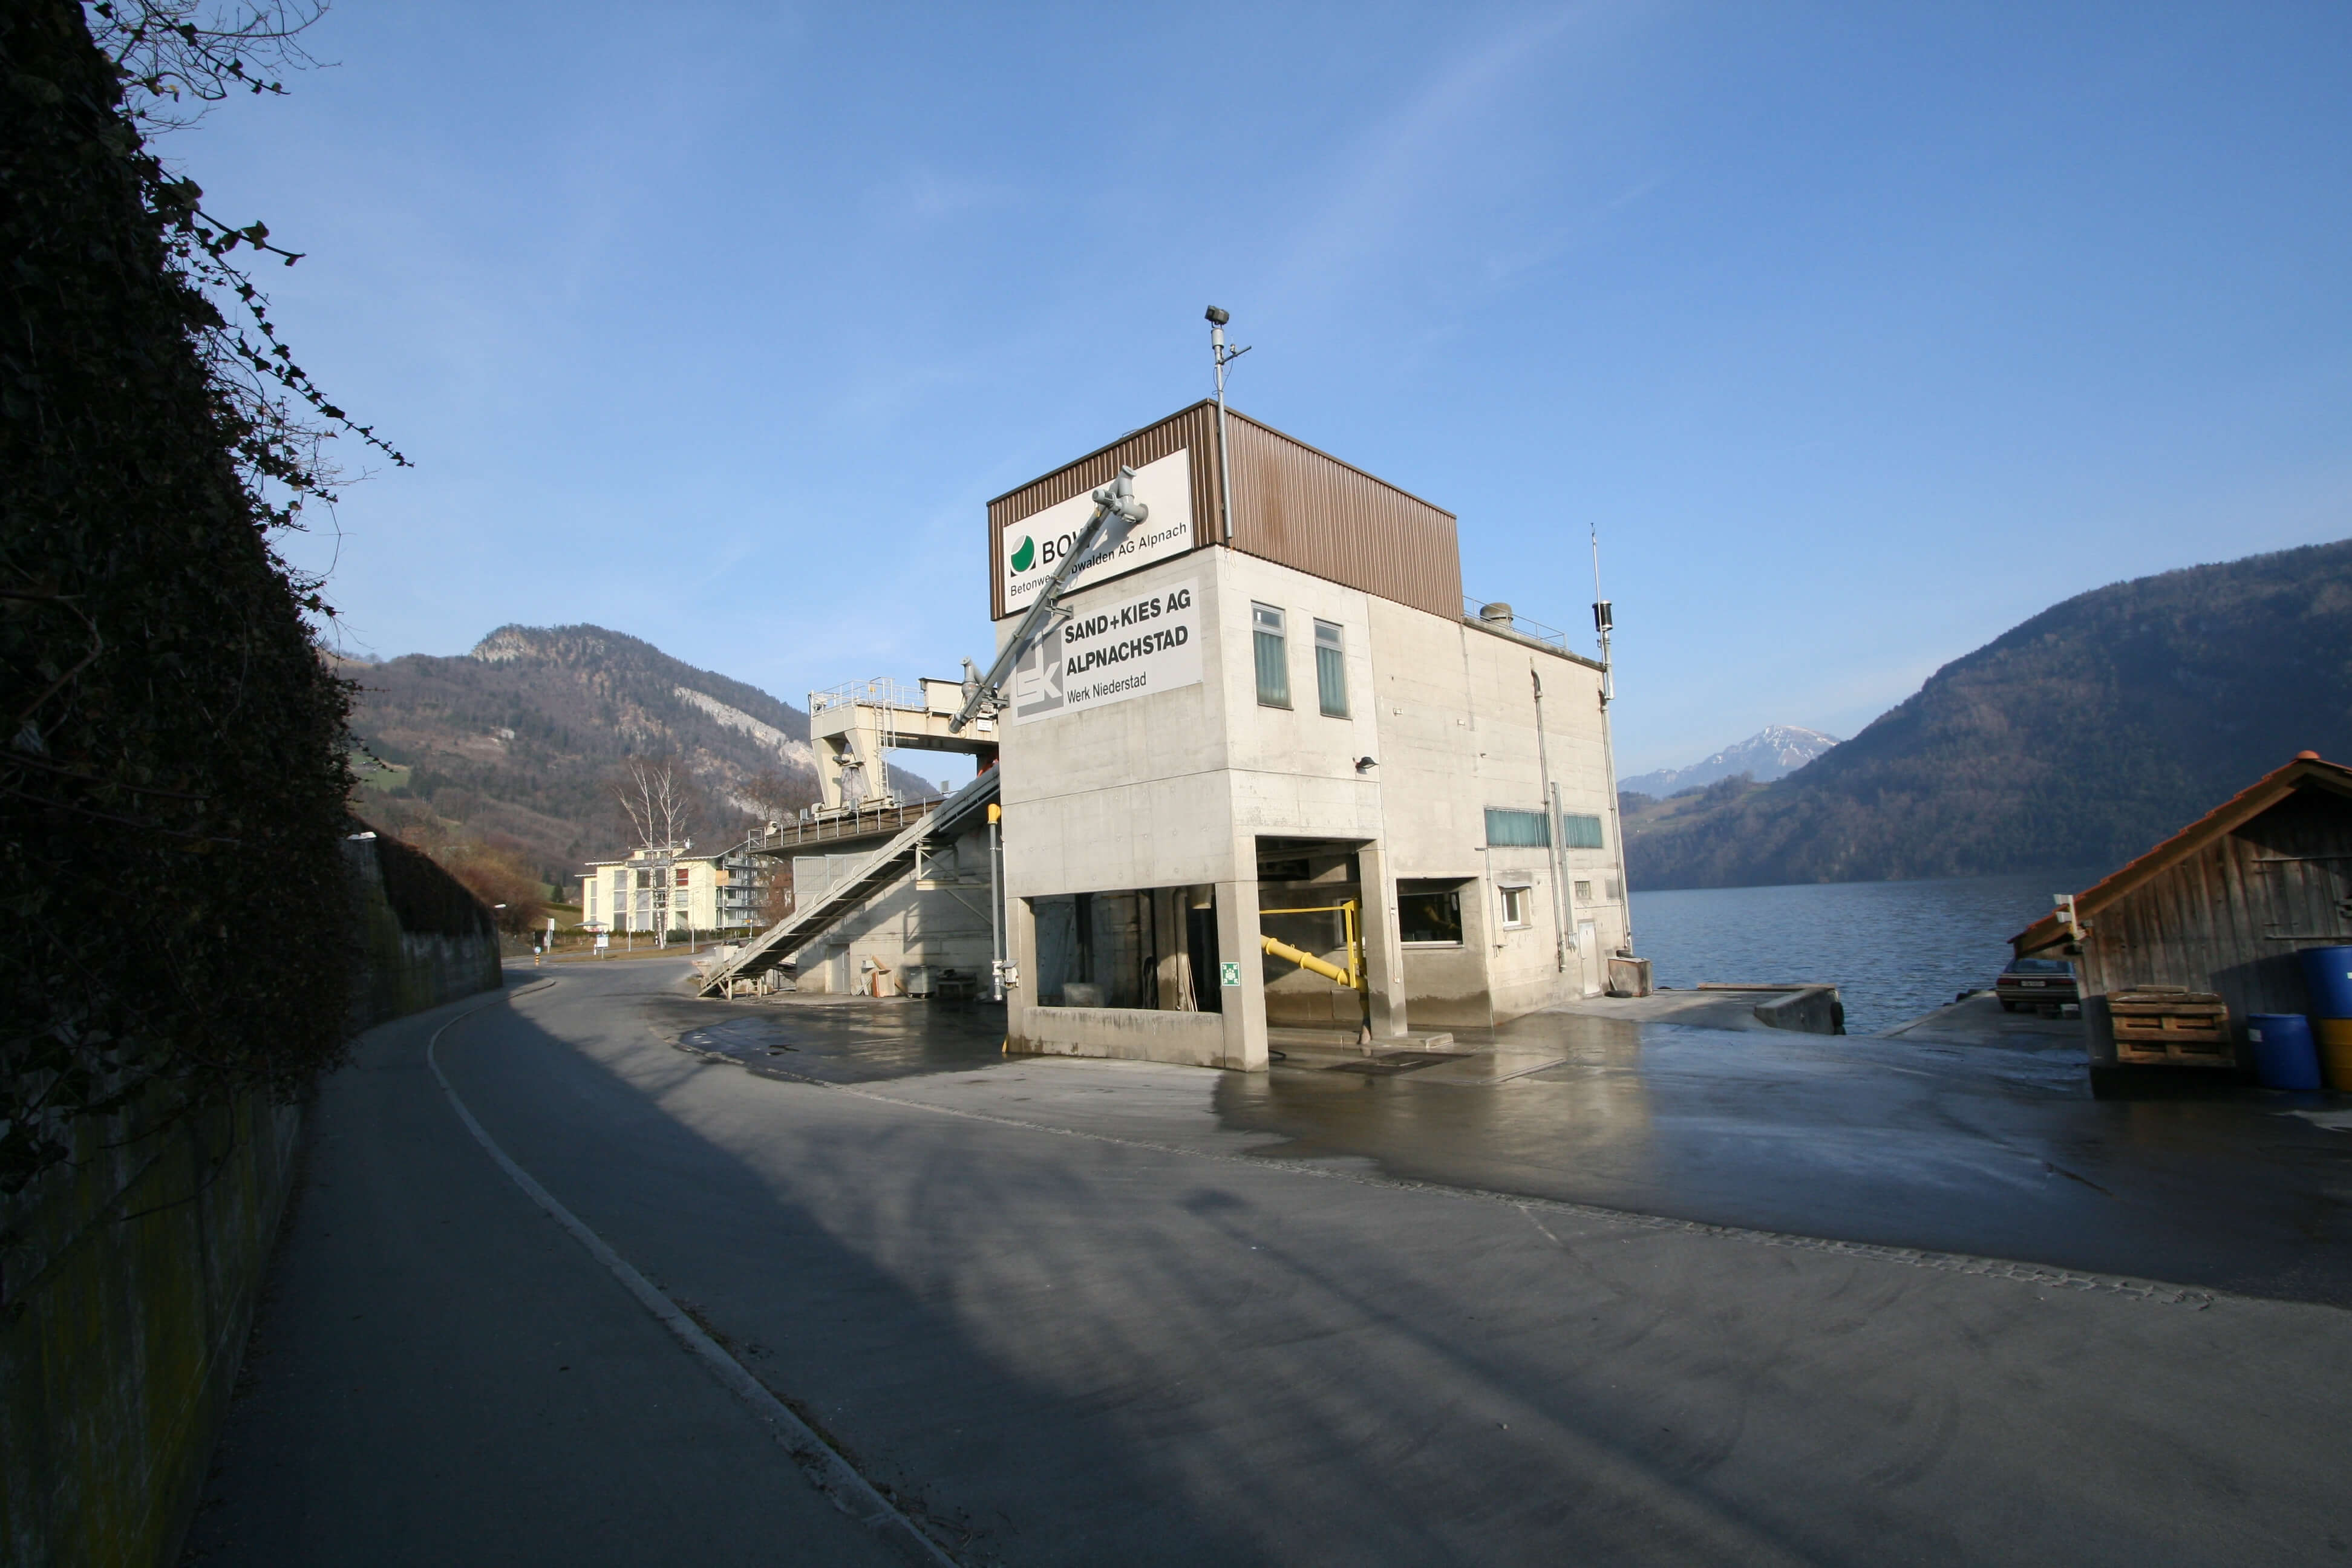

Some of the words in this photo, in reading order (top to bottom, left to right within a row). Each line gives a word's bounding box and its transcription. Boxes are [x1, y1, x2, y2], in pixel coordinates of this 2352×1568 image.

[1011, 574, 1053, 596] Betonwe
[1071, 551, 1114, 574] bwalden
[1118, 541, 1135, 557] AG
[1138, 522, 1186, 550] Alpnach
[1065, 598, 1161, 644] SAND+KIES
[1166, 589, 1191, 613] AG
[1067, 626, 1188, 676] ALPNACHSTAD
[1067, 685, 1090, 704] Werk
[1093, 671, 1147, 698] Niederstad
